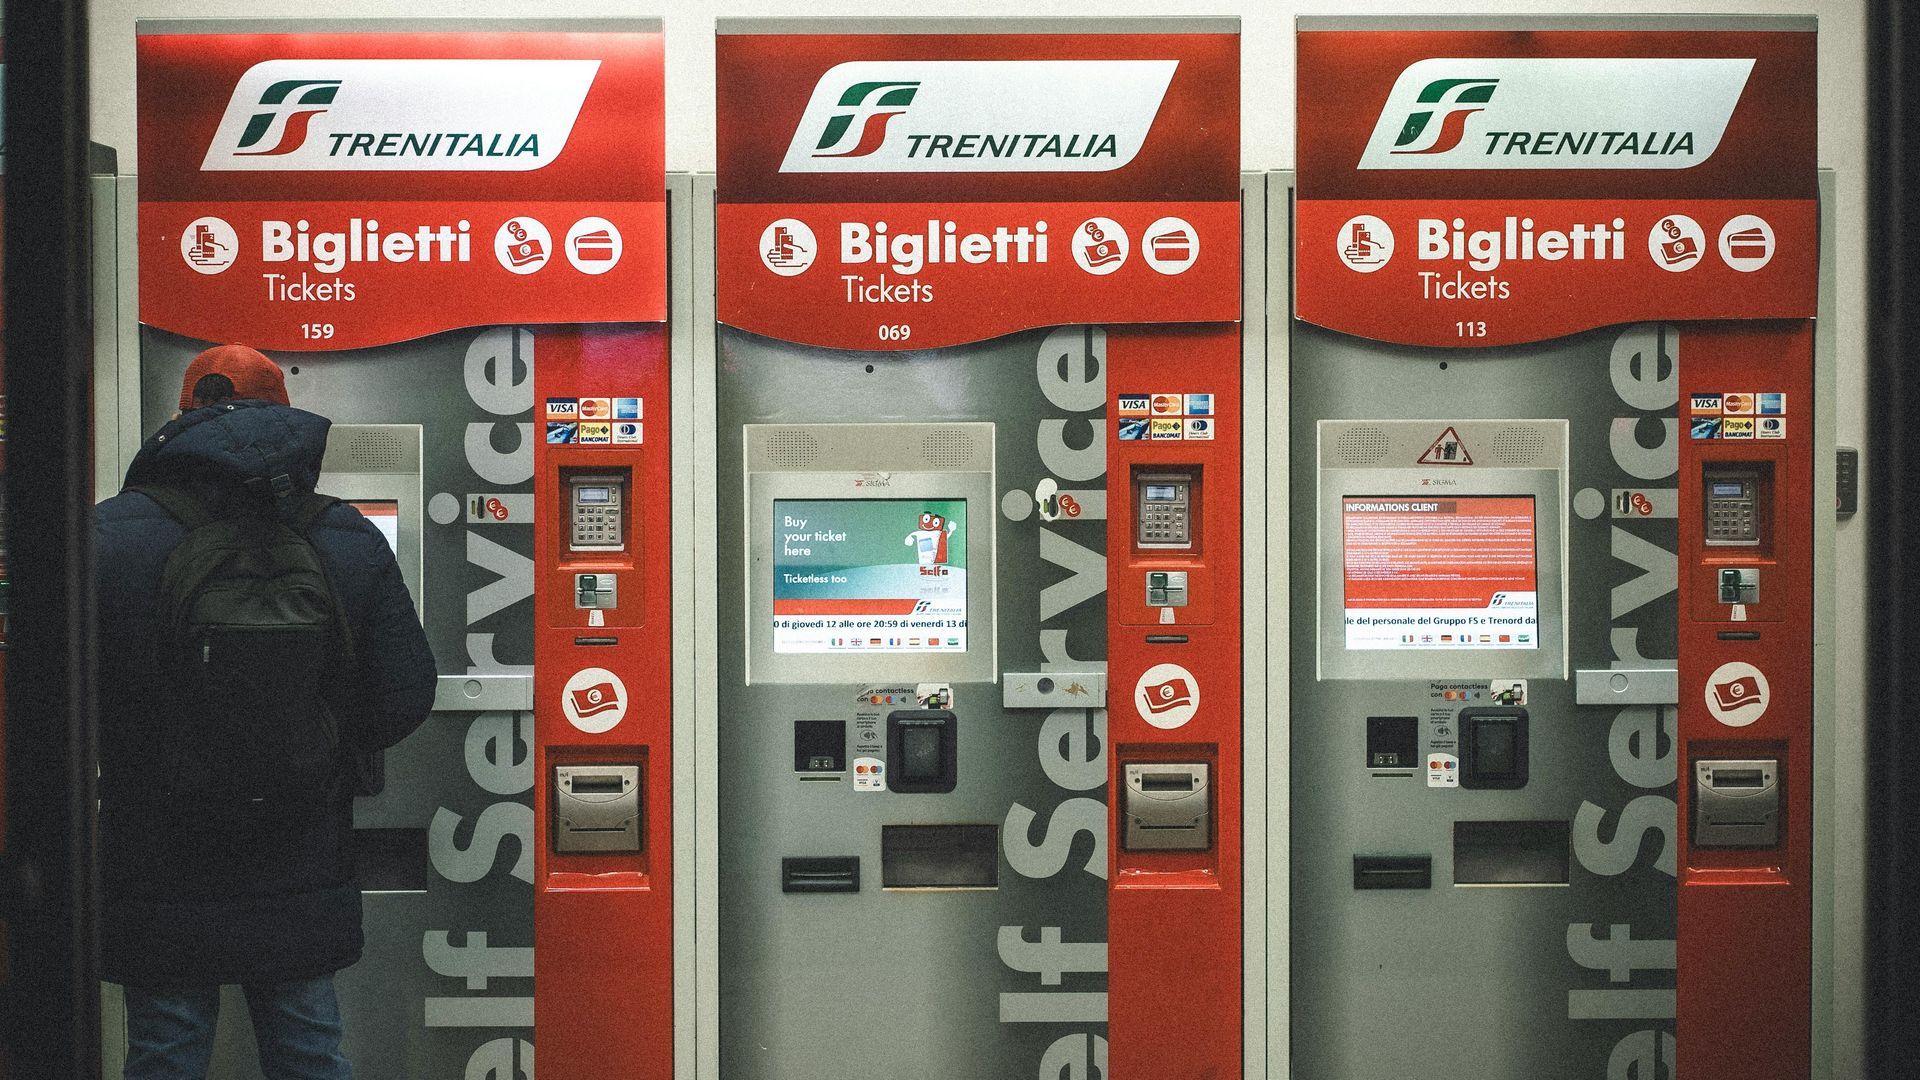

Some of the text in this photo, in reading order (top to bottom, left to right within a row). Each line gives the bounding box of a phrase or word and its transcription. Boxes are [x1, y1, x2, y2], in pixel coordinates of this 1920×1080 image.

[328, 133, 540, 157] TRENITALIA
[906, 134, 1118, 158] TRENITALIA
[1485, 131, 1695, 155] TRENITALIA
[262, 218, 471, 273] Biglietti
[840, 220, 1048, 275] Biglietti
[1418, 216, 1625, 272] Biglietti
[262, 274, 356, 302] Tickets
[841, 275, 934, 304] Tickets
[1418, 272, 1510, 300] Tickets
[300, 323, 334, 340] 159
[878, 325, 911, 341] 069
[1456, 321, 1486, 337] 113
[550, 403, 574, 413] VISA
[1122, 400, 1146, 409] VISA
[1695, 399, 1718, 408] VISA
[581, 425, 600, 435] Pago
[1153, 421, 1172, 431] Pago
[1725, 420, 1744, 430] Pago
[1346, 503, 1438, 512] INFORMATIONS CLIENT
[784, 516, 807, 529] Buy
[784, 530, 846, 544] your ticket
[784, 544, 811, 556] here
[783, 573, 847, 583] Ticketless too
[781, 620, 790, 628] di
[826, 620, 836, 628] 12
[839, 620, 855, 628] alle
[873, 620, 898, 628] 20:59
[900, 620, 909, 628] di
[947, 620, 957, 628] 13
[1356, 617, 1370, 625] del
[1372, 617, 1416, 626] personale
[1417, 617, 1431, 625] del
[1433, 617, 1466, 626] Gruppo
[1468, 617, 1479, 625] FS
[1488, 617, 1523, 625] Trenord
[1525, 617, 1536, 625] da
[423, 930, 534, 1080] elf
[997, 925, 1108, 1080] elf
[1567, 923, 1678, 1080] elf
